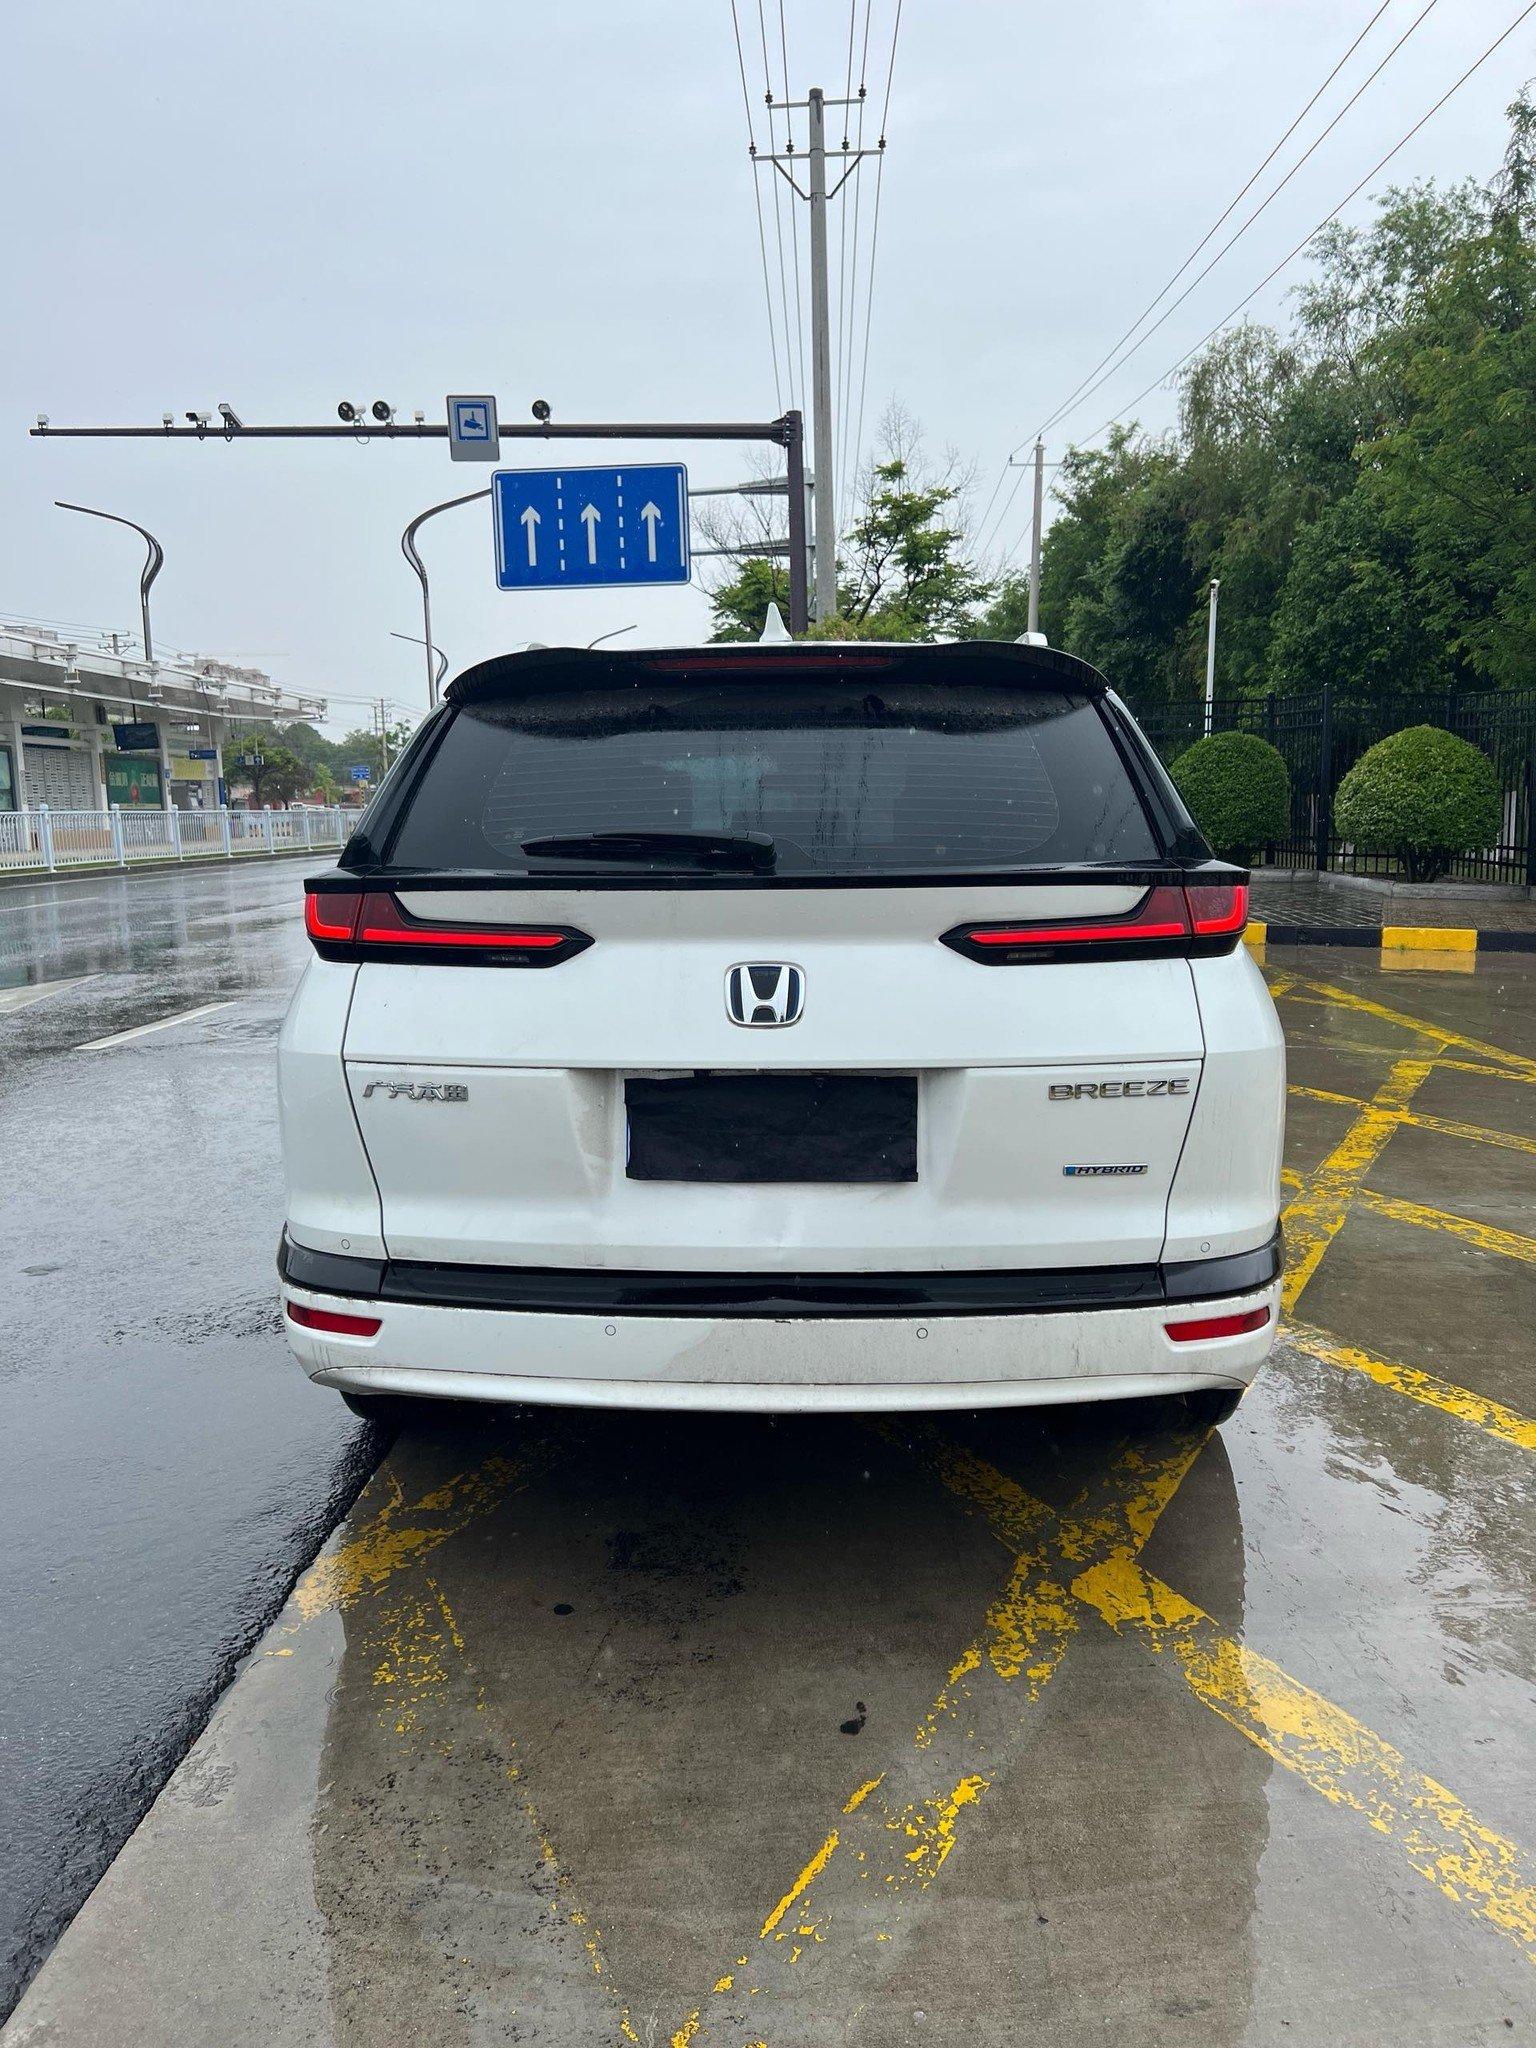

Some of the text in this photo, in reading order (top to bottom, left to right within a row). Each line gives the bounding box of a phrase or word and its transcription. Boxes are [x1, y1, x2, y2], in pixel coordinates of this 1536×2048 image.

[362, 1081, 468, 1102] 广汽本田
[1048, 1077, 1190, 1101] BREEZE
[1076, 1164, 1145, 1175] HYBRID
